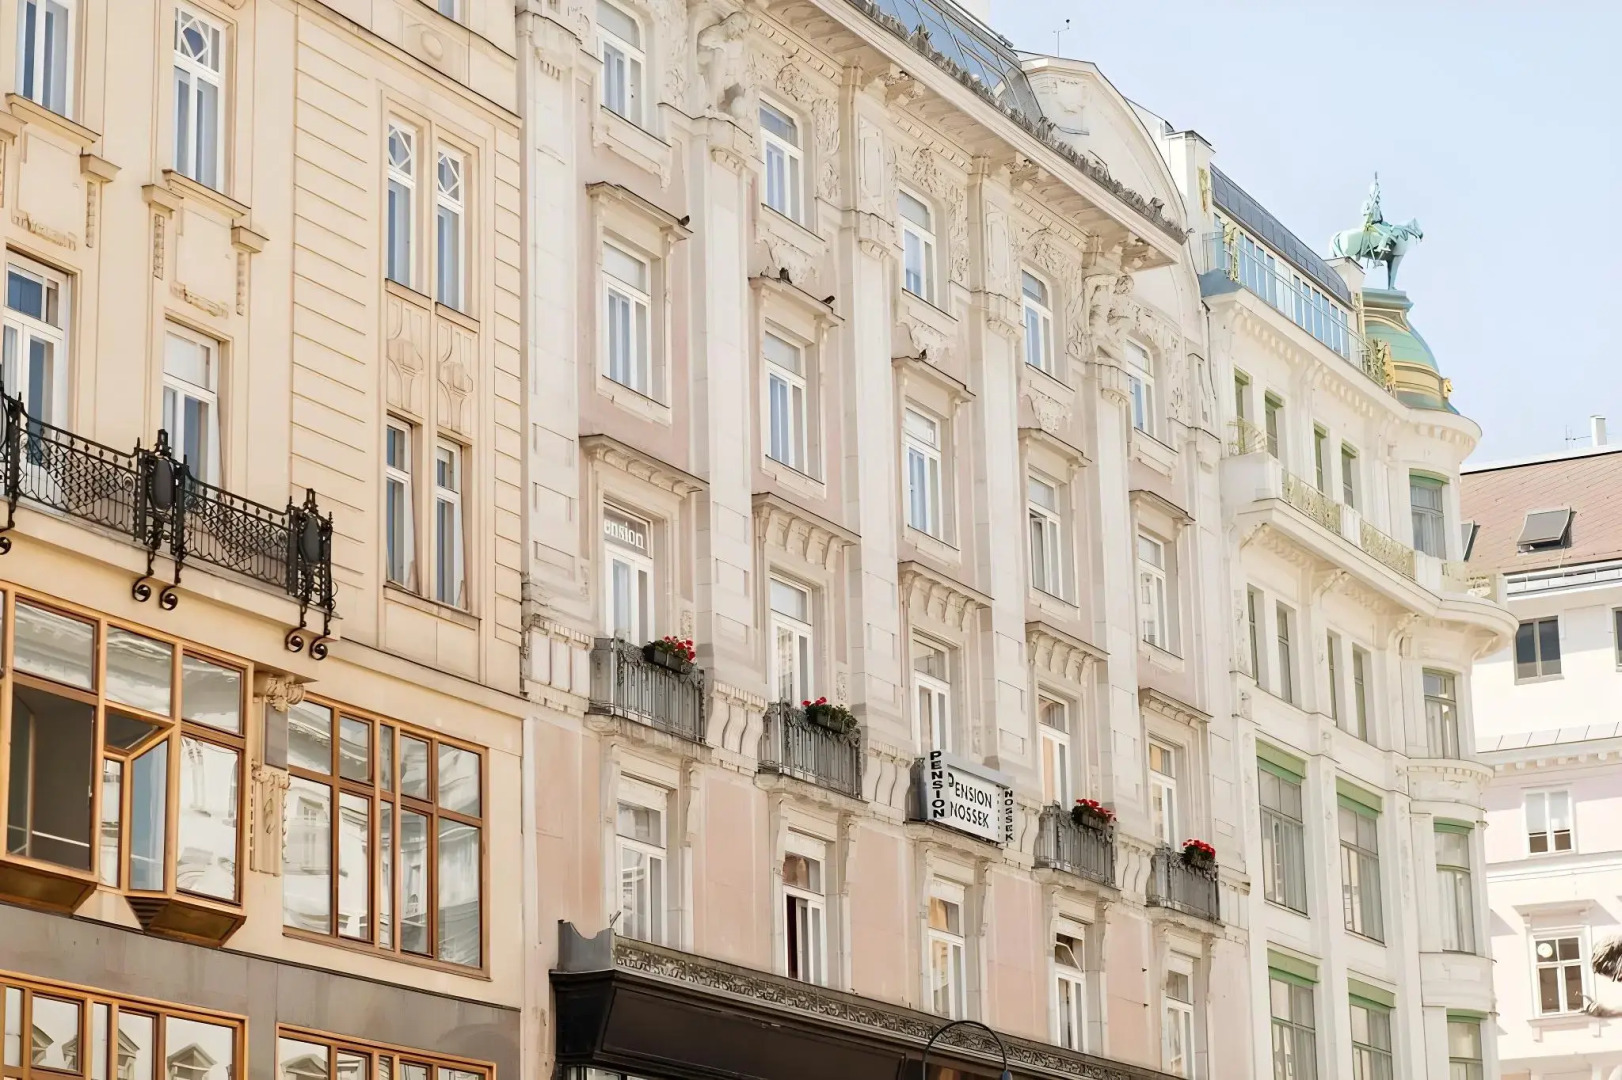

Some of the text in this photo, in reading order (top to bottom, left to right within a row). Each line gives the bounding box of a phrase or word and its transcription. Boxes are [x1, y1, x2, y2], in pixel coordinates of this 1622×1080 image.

[930, 750, 945, 818] PENSION
[950, 801, 989, 829] NOSSEK
[1004, 790, 1013, 842] NOSSEK
